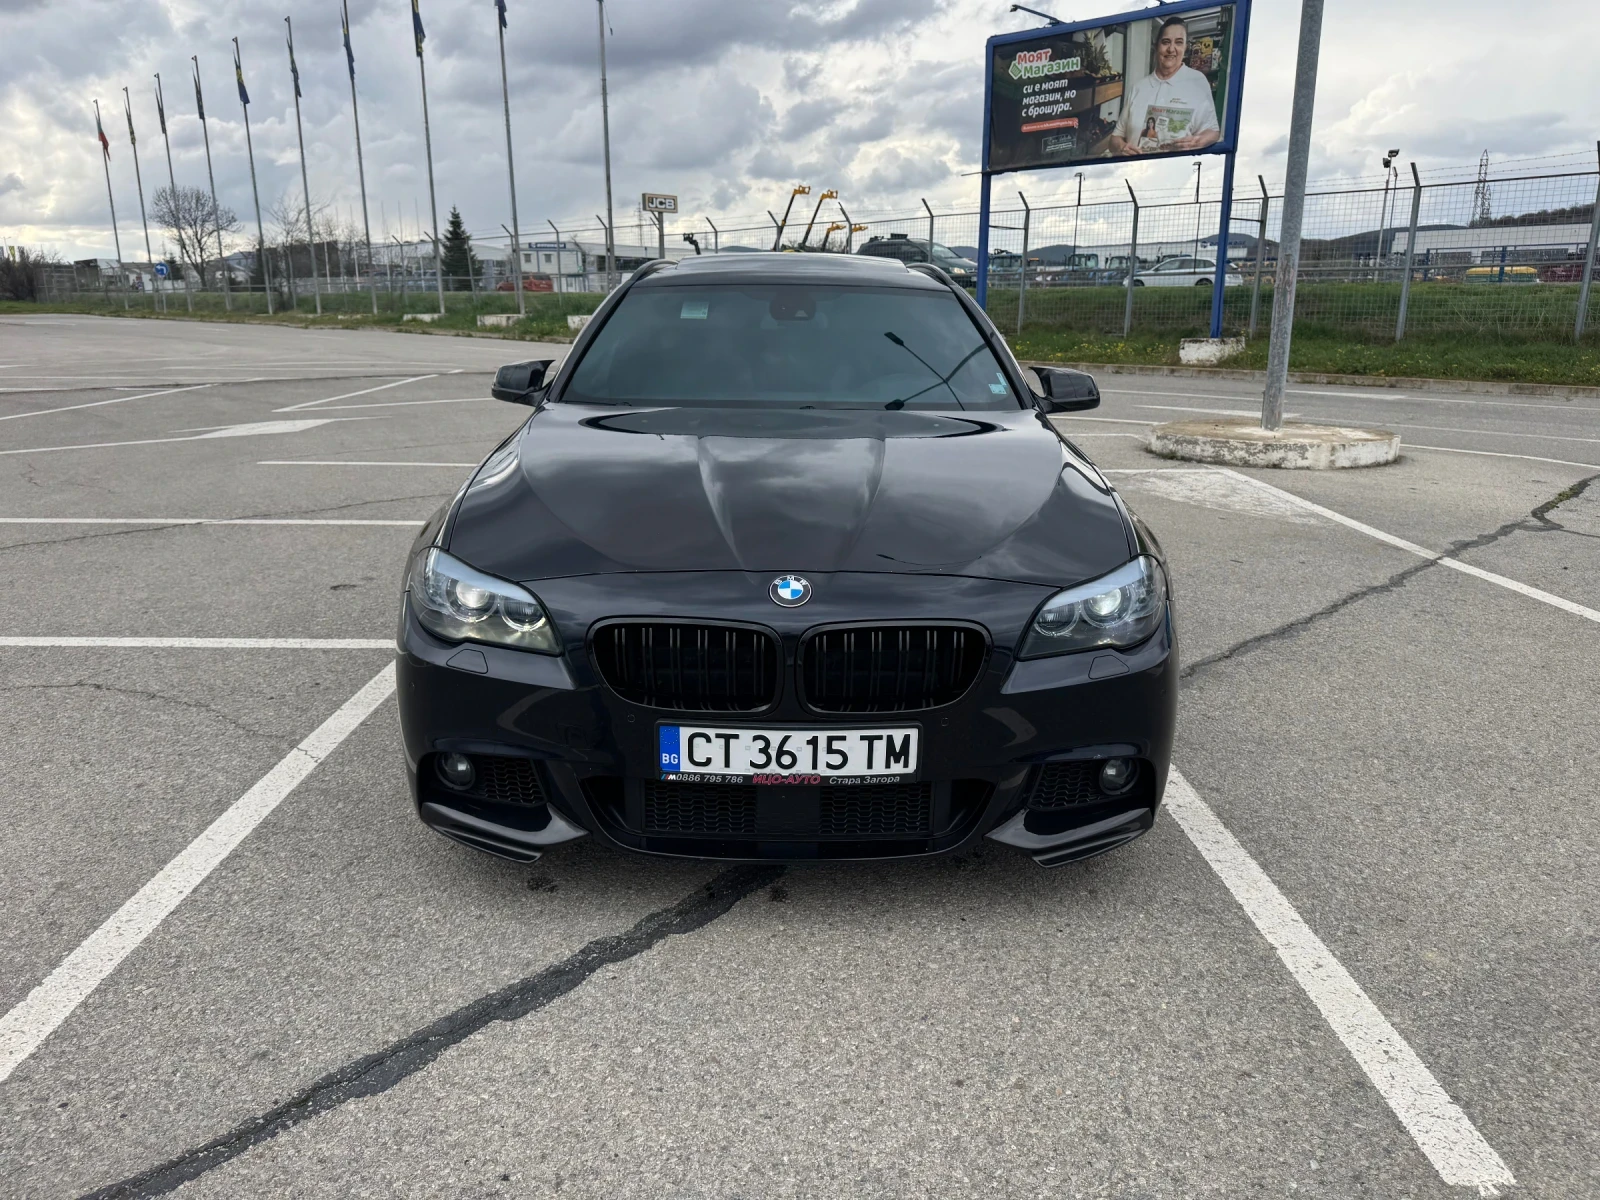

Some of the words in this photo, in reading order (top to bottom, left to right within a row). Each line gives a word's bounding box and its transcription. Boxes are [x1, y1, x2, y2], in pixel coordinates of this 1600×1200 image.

[1017, 48, 1051, 65] Моят
[1022, 58, 1080, 78] Магазин
[1023, 84, 1034, 93] си
[1034, 84, 1040, 92] е
[1041, 79, 1068, 91] моят
[1022, 92, 1063, 105] магазин,
[1064, 89, 1077, 99] но
[1021, 109, 1026, 117] с
[1028, 102, 1073, 118] брошура.
[648, 197, 675, 209] JCB
[774, 574, 808, 586] BMW
[687, 732, 740, 769] CT
[749, 733, 848, 771] 3615
[859, 733, 911, 769] TM
[661, 753, 678, 764] BG
[704, 774, 722, 783] 795
[725, 775, 743, 784] 786
[752, 773, 821, 786] ИЦО-АУТО
[828, 775, 862, 786] Стара
[863, 774, 901, 785] Загора
